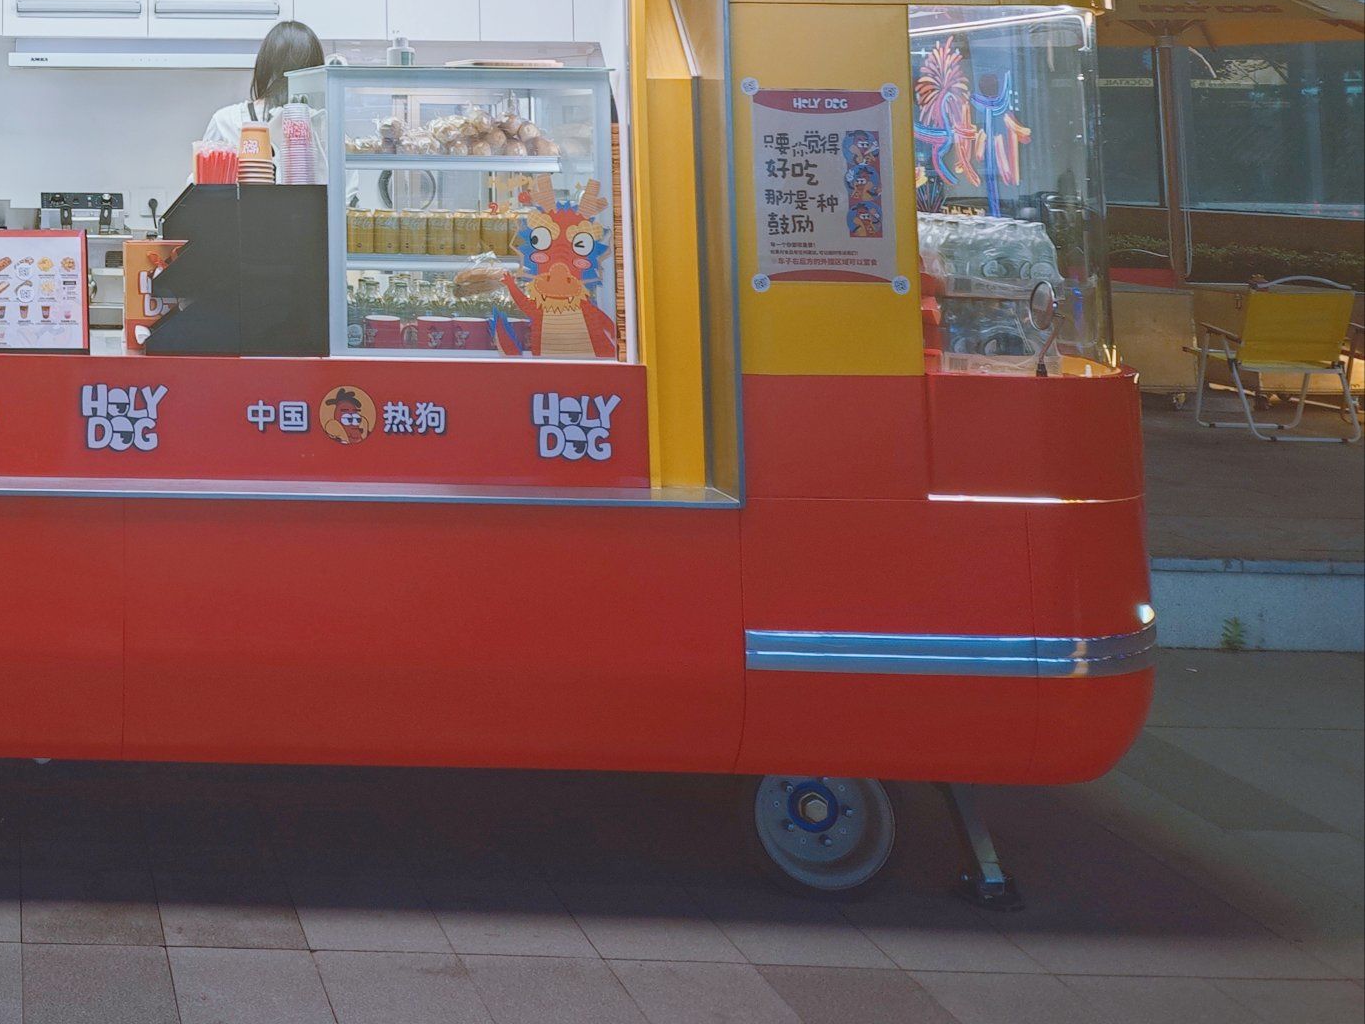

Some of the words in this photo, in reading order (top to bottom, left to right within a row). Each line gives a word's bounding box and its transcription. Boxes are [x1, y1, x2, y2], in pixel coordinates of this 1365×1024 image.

[793, 97, 821, 109] HOLY
[825, 97, 848, 109] DOG
[764, 131, 840, 157] 只要你觉得
[765, 158, 818, 186] 好吃
[765, 189, 839, 213] 那才是一种
[768, 212, 814, 235] 鼓励
[81, 383, 169, 420] HOLY
[246, 399, 308, 432] 中国
[383, 401, 446, 434] 热狗
[533, 392, 621, 428] HOLY
[87, 416, 158, 452] DOG
[539, 425, 612, 461] DOG
